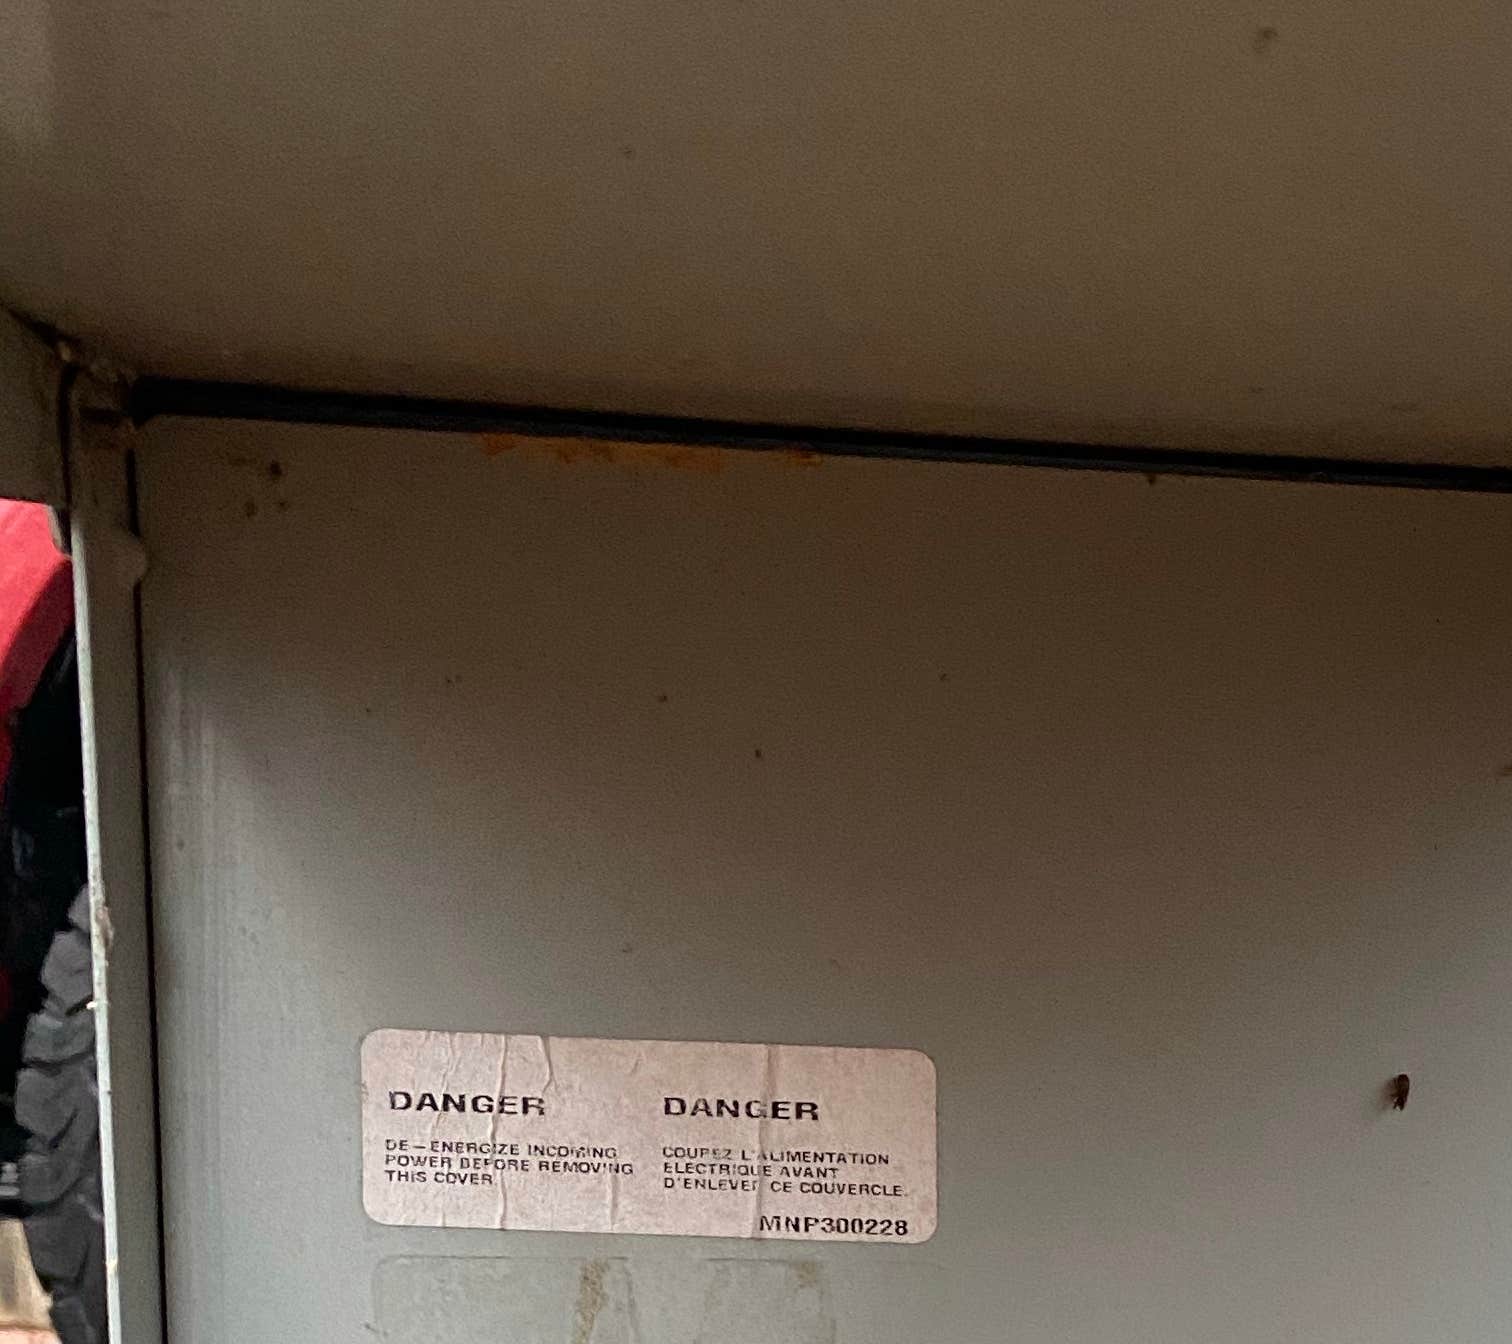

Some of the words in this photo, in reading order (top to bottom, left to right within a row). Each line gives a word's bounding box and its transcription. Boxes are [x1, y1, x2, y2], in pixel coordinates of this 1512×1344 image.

[388, 1090, 546, 1116] DANGER
[662, 1096, 820, 1121] DANGER
[528, 1144, 618, 1159] INCOMING
[662, 1146, 733, 1161] COUPEZ
[741, 1149, 890, 1167] L'ALIMENTATION
[385, 1155, 452, 1170] POWER
[460, 1157, 530, 1172] BEFORE
[538, 1160, 634, 1176] REMOVING
[663, 1162, 773, 1177] ELECTRIQUE
[780, 1166, 839, 1179] AVANT
[385, 1170, 428, 1184] THIS
[433, 1172, 493, 1186] COVER
[770, 1181, 793, 1193] CE
[759, 1215, 910, 1238] MNP300228
